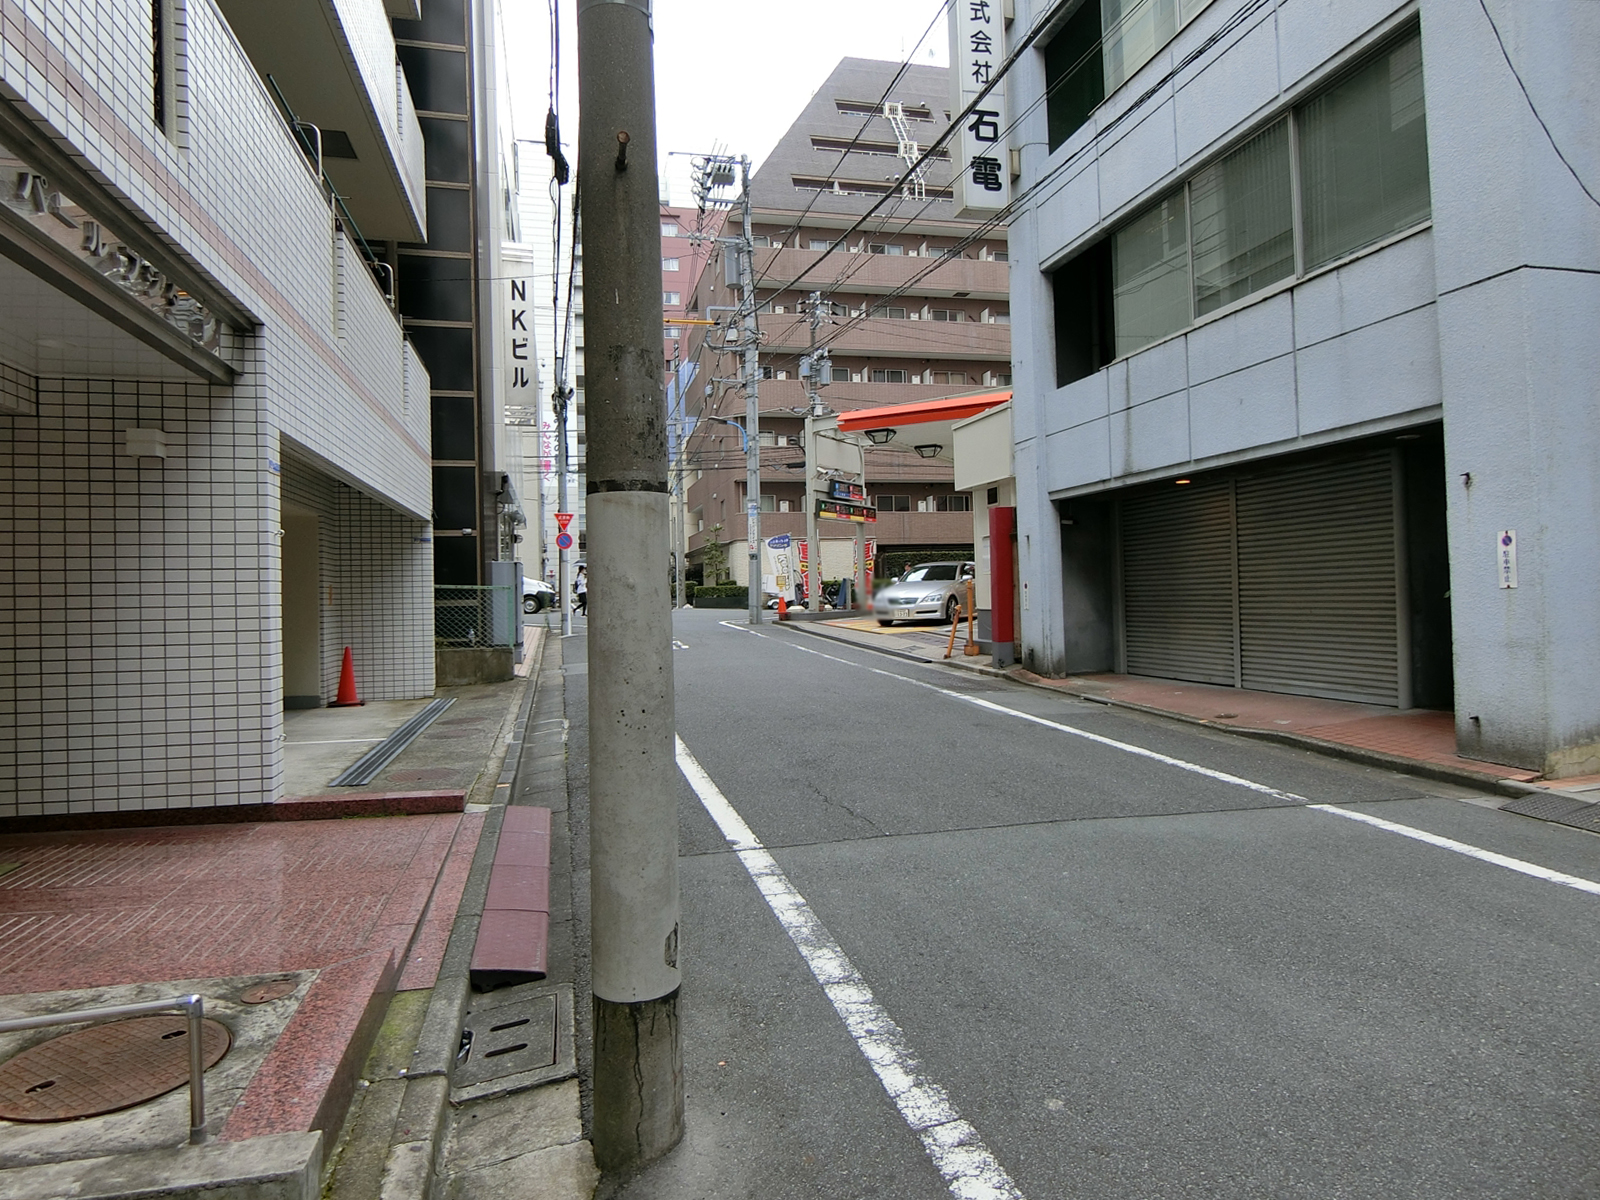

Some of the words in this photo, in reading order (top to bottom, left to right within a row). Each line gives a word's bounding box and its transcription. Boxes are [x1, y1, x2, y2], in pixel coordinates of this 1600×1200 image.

[970, 0, 993, 84] 式会社
[968, 108, 1002, 192] 石電
[511, 279, 529, 389] NKビル
